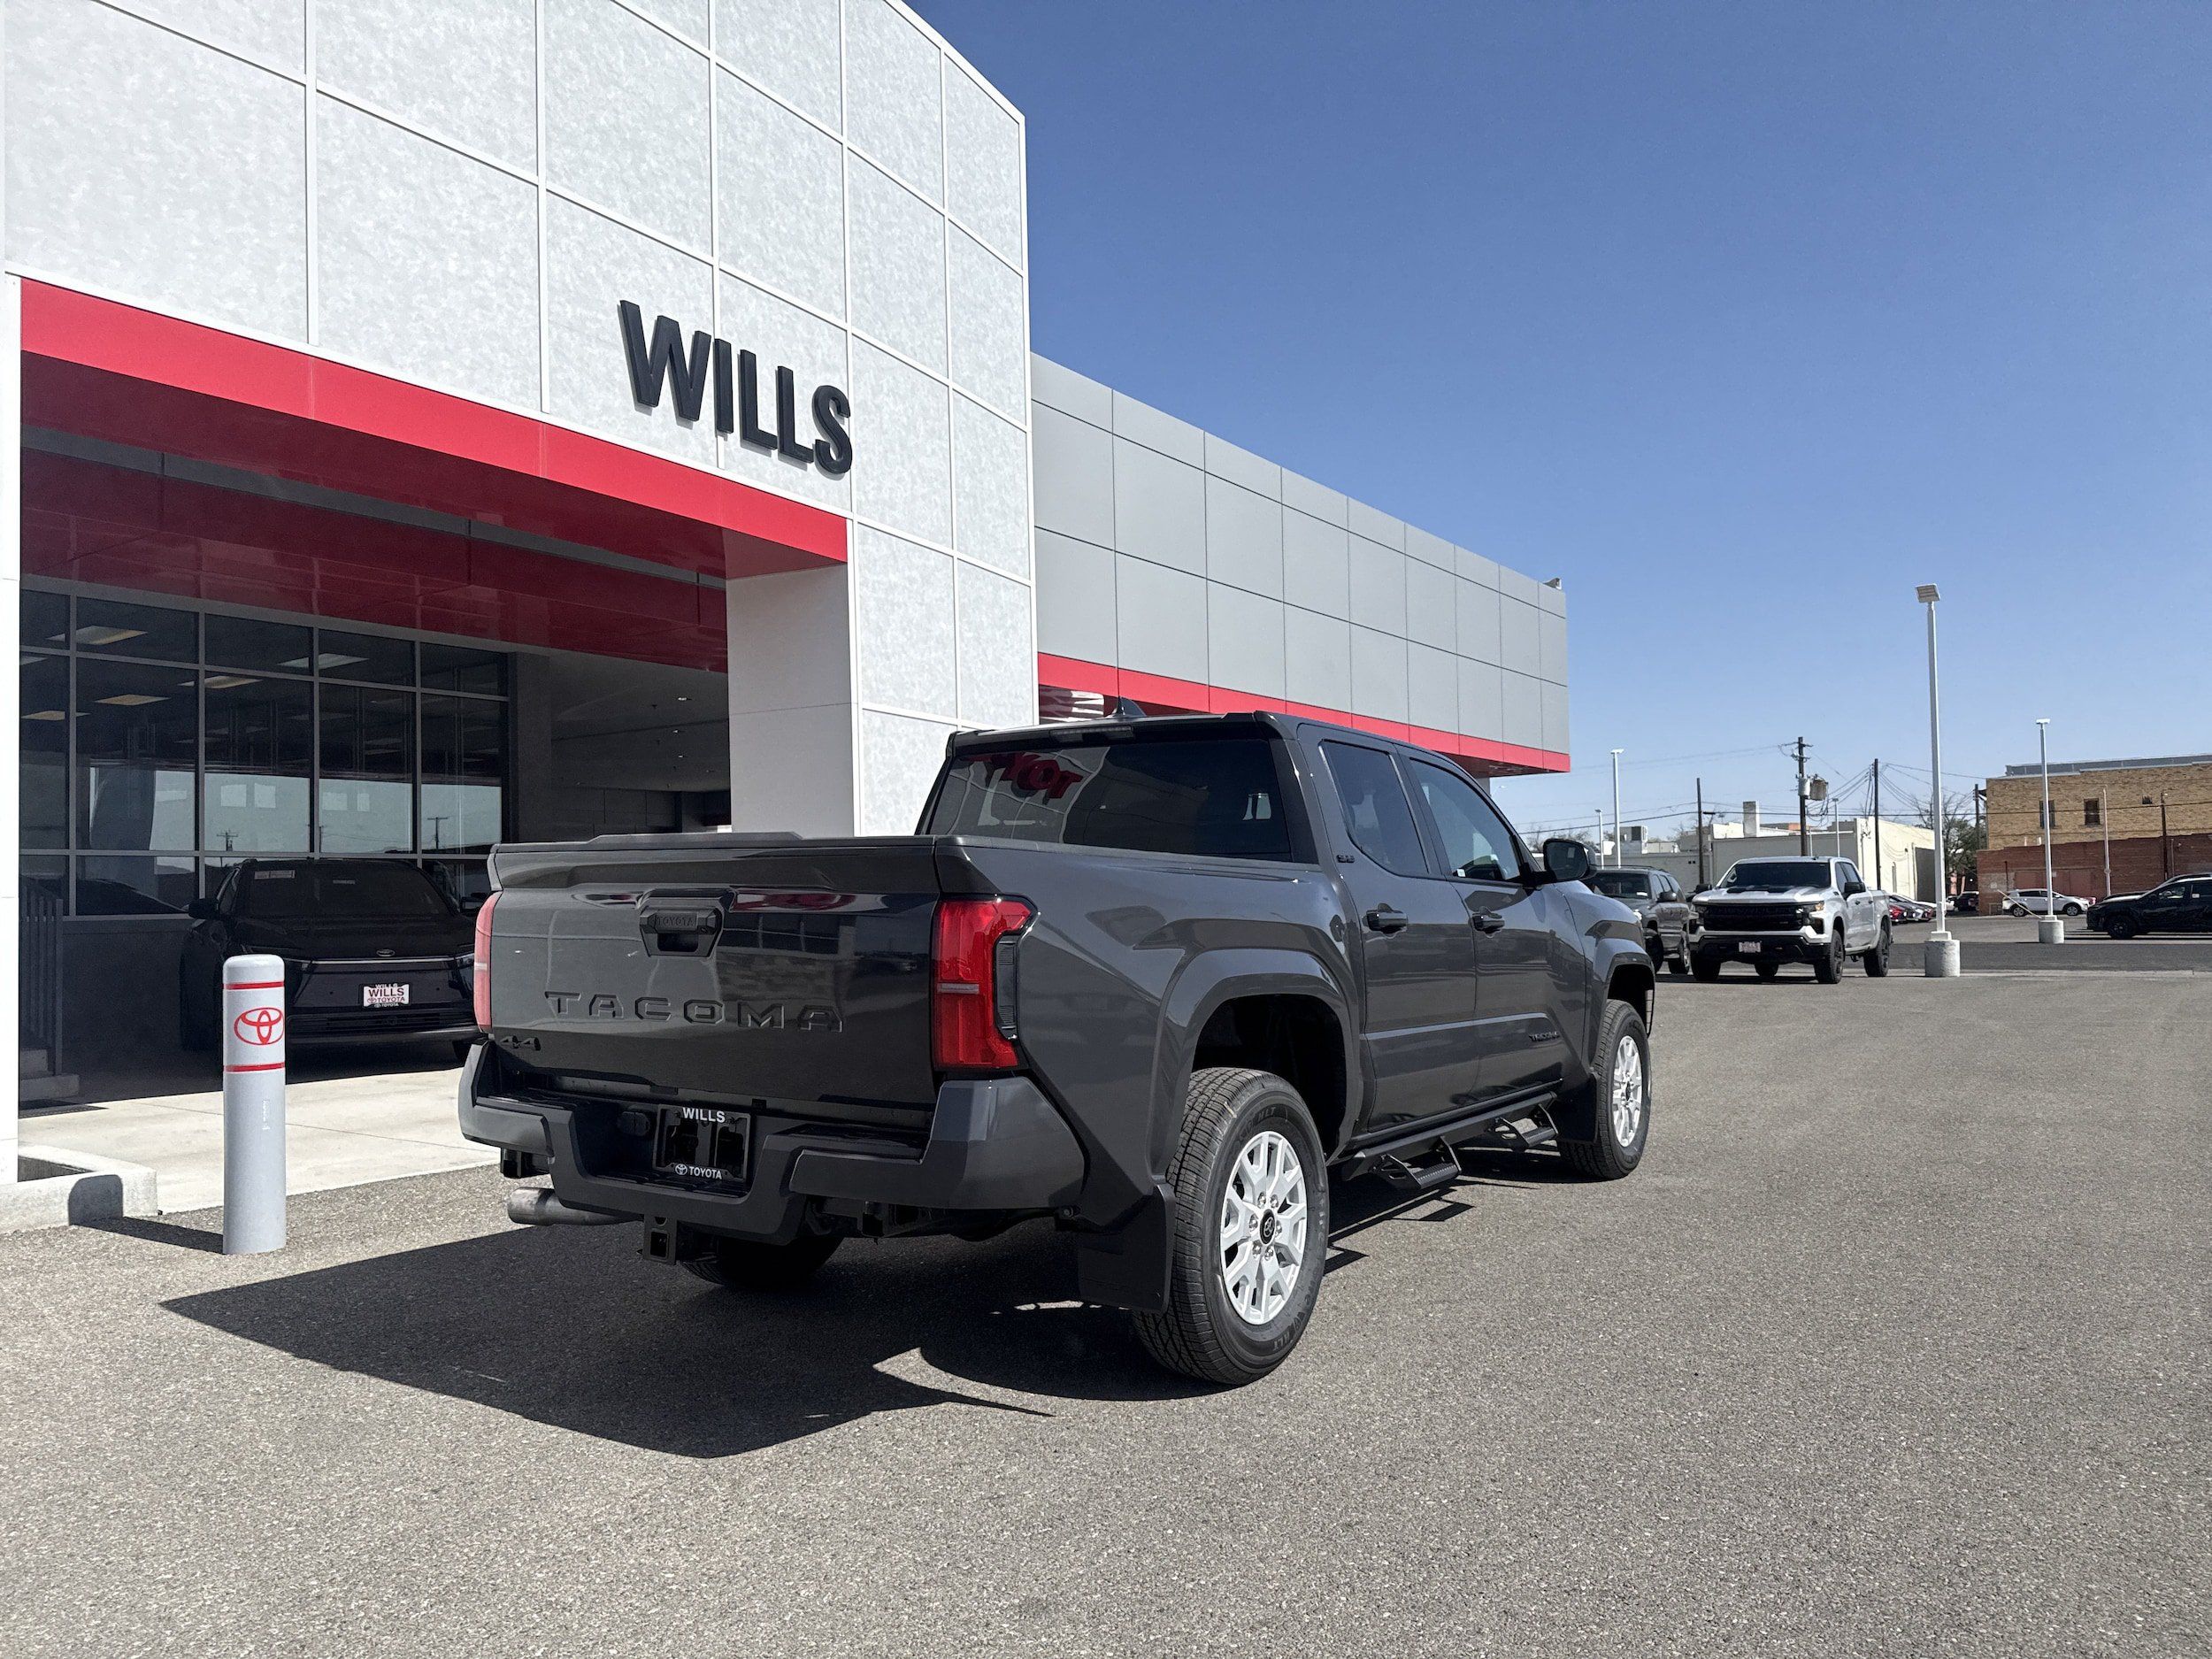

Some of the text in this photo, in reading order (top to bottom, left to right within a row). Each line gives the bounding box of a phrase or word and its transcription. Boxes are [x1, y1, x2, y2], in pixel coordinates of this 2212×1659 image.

[618, 299, 853, 476] WILLS
[657, 916, 695, 926] TOYOTA
[368, 987, 404, 997] WILLS
[544, 990, 843, 1033] TACOMA
[682, 1107, 726, 1123] WILLS
[689, 1166, 722, 1179] TOYOTA
